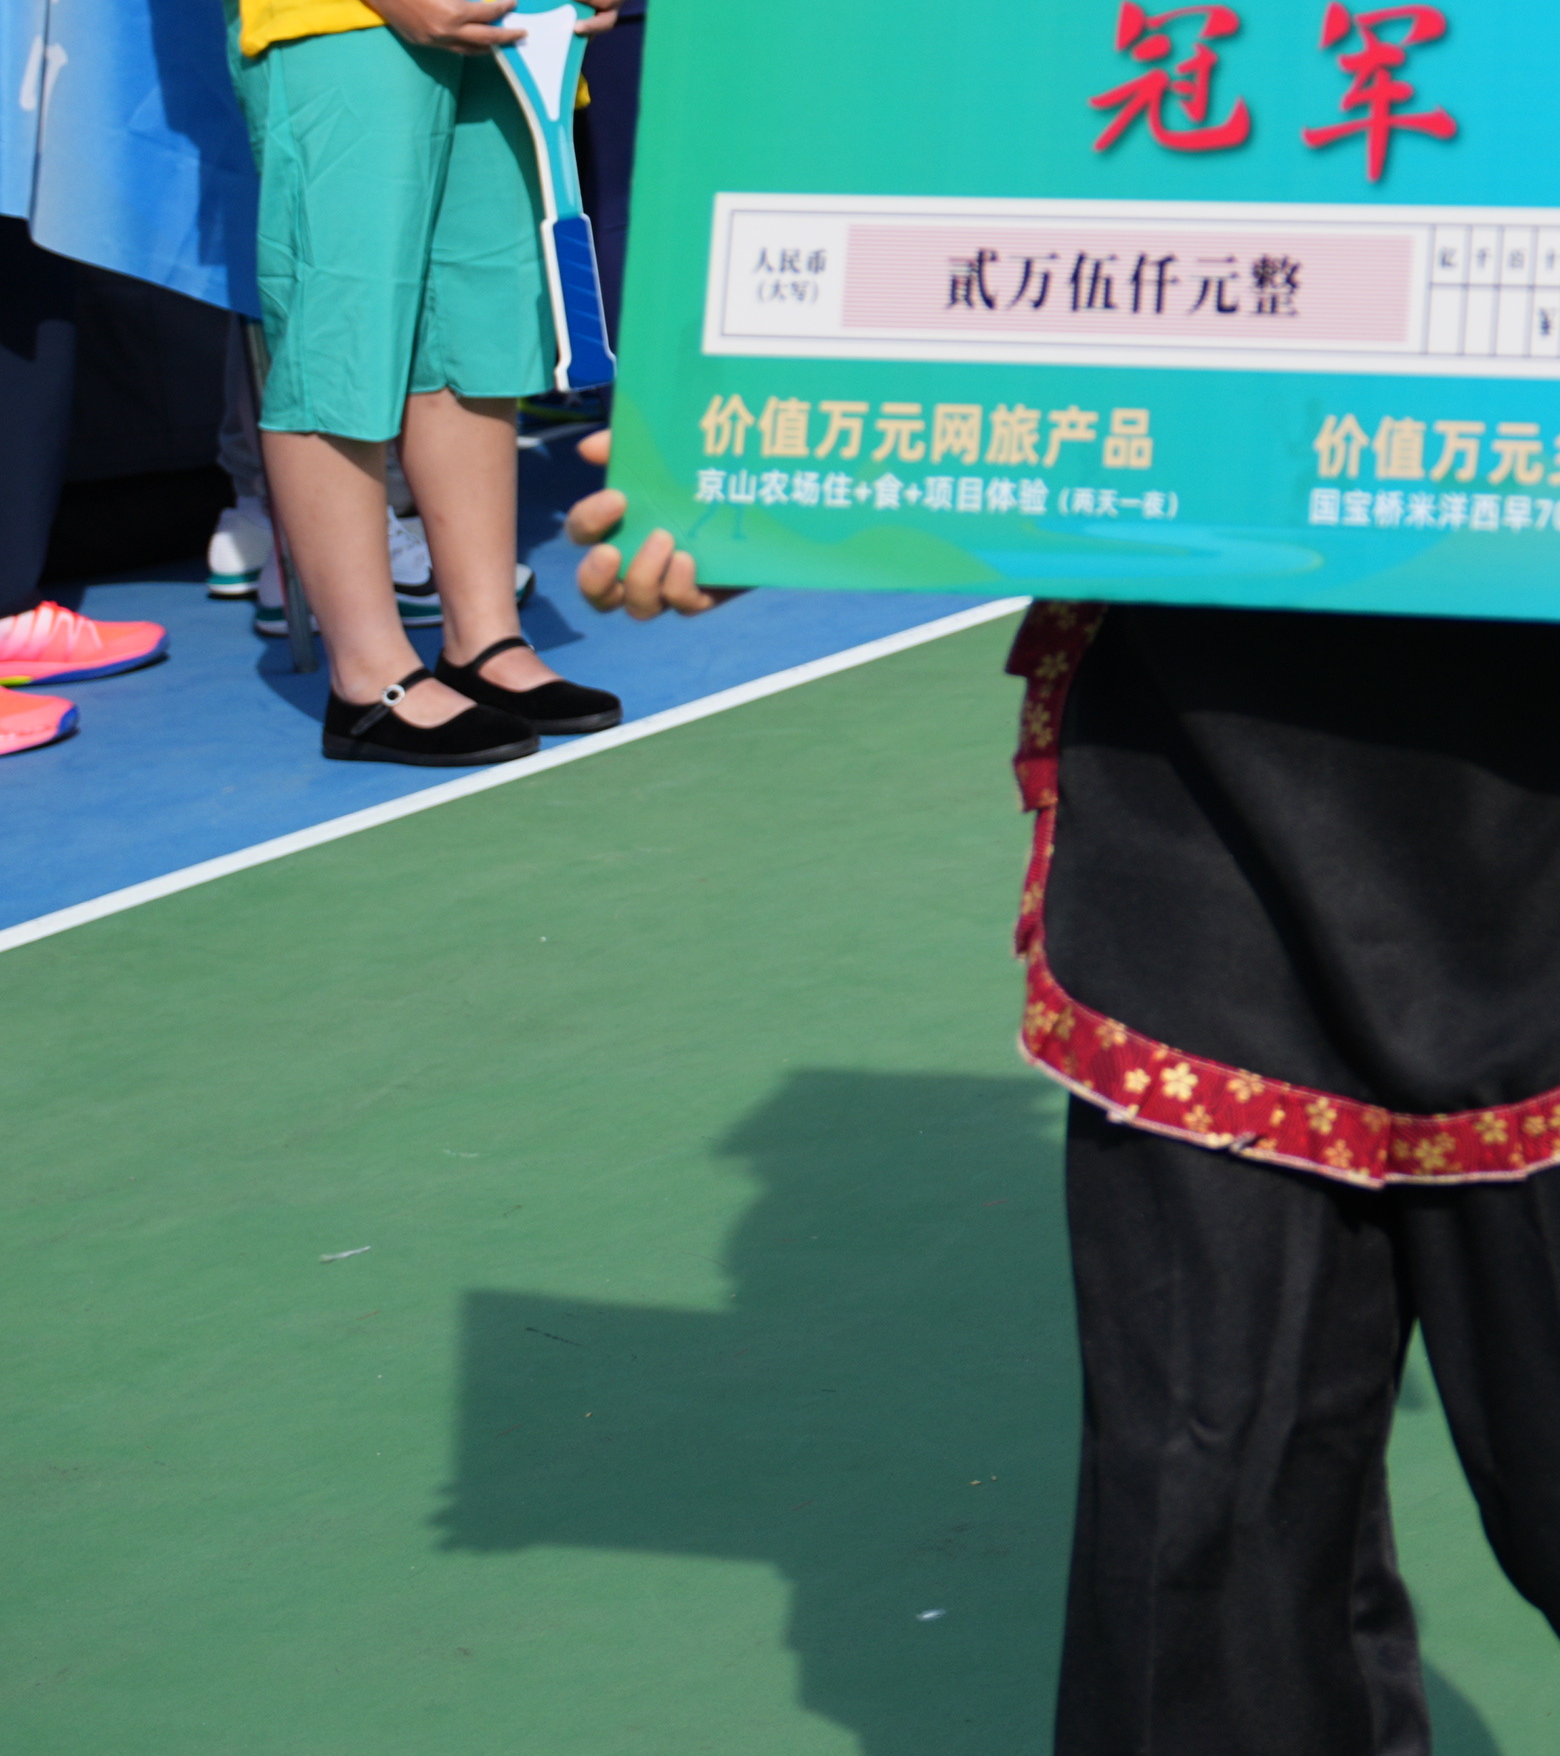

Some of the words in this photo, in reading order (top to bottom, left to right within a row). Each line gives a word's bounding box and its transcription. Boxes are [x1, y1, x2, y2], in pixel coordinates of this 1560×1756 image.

[1089, 0, 1458, 183] 冠军
[750, 247, 828, 275] 人民币
[700, 394, 1154, 470] 价值万元网旅产品
